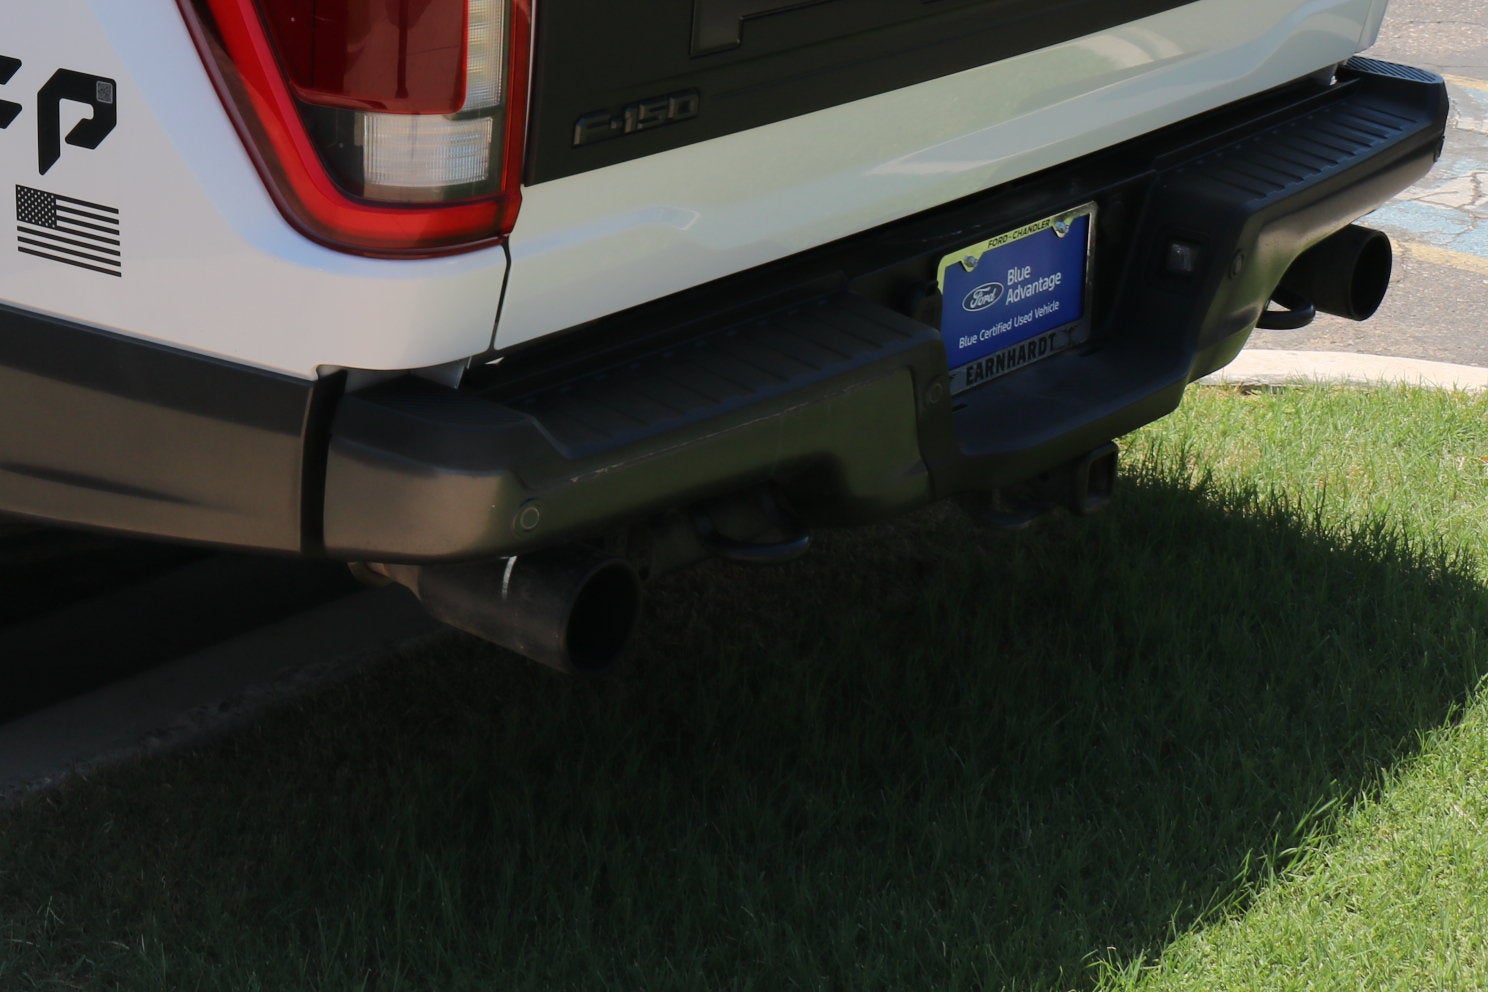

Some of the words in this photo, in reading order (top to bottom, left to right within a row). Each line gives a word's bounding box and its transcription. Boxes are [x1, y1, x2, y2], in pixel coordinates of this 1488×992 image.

[572, 69, 701, 149] F-150
[1005, 271, 1062, 306] Advantage
[1007, 265, 1032, 286] Blue
[970, 286, 998, 309] Ford
[959, 334, 978, 349] Blue
[979, 319, 1012, 341] Certified
[1014, 310, 1033, 328] Used
[1034, 300, 1060, 319] Vehicle
[965, 332, 1057, 386] EARNHARDT
